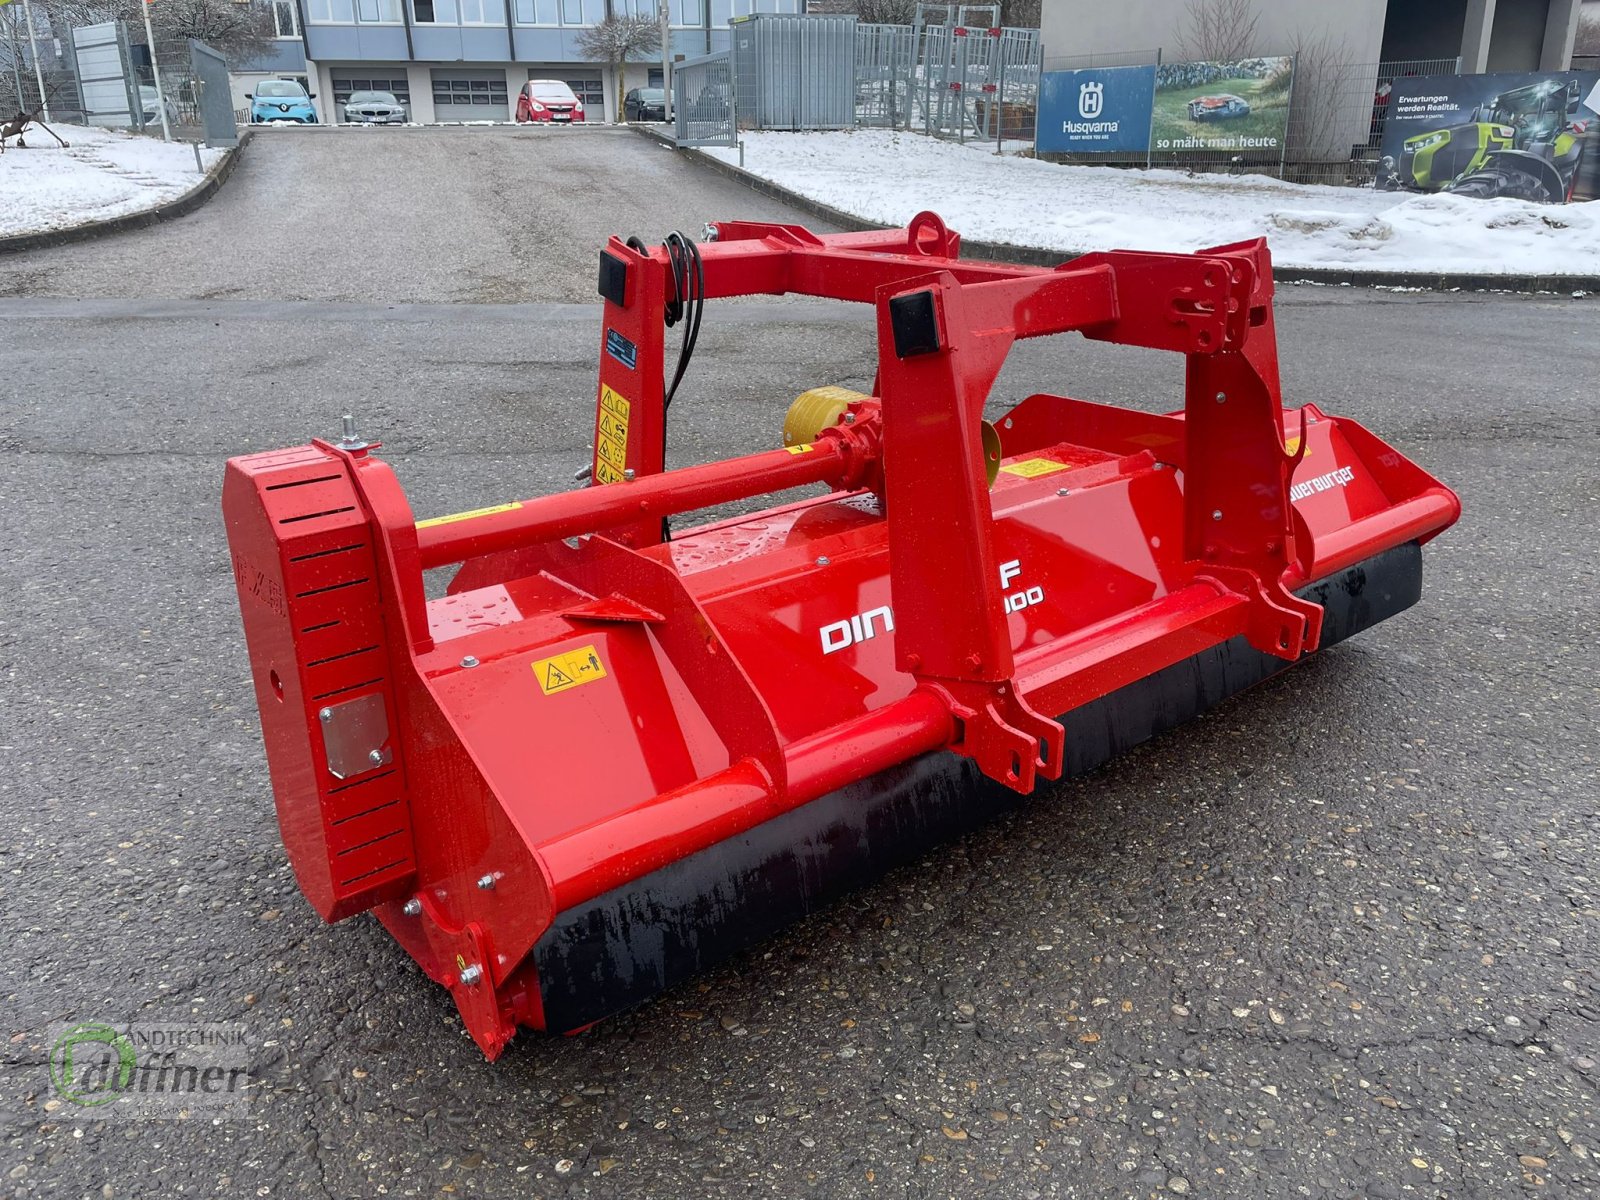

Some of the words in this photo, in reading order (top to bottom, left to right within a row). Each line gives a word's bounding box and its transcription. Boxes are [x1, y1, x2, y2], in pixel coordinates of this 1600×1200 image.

[1398, 96, 1448, 104] Erwartungen
[1427, 103, 1460, 111] Realität.
[1063, 121, 1118, 134] Husqvarna
[1156, 139, 1170, 148] so
[1172, 136, 1204, 148] mäht
[1207, 138, 1235, 147] man
[1239, 135, 1277, 147] heute
[1000, 559, 1022, 590] F
